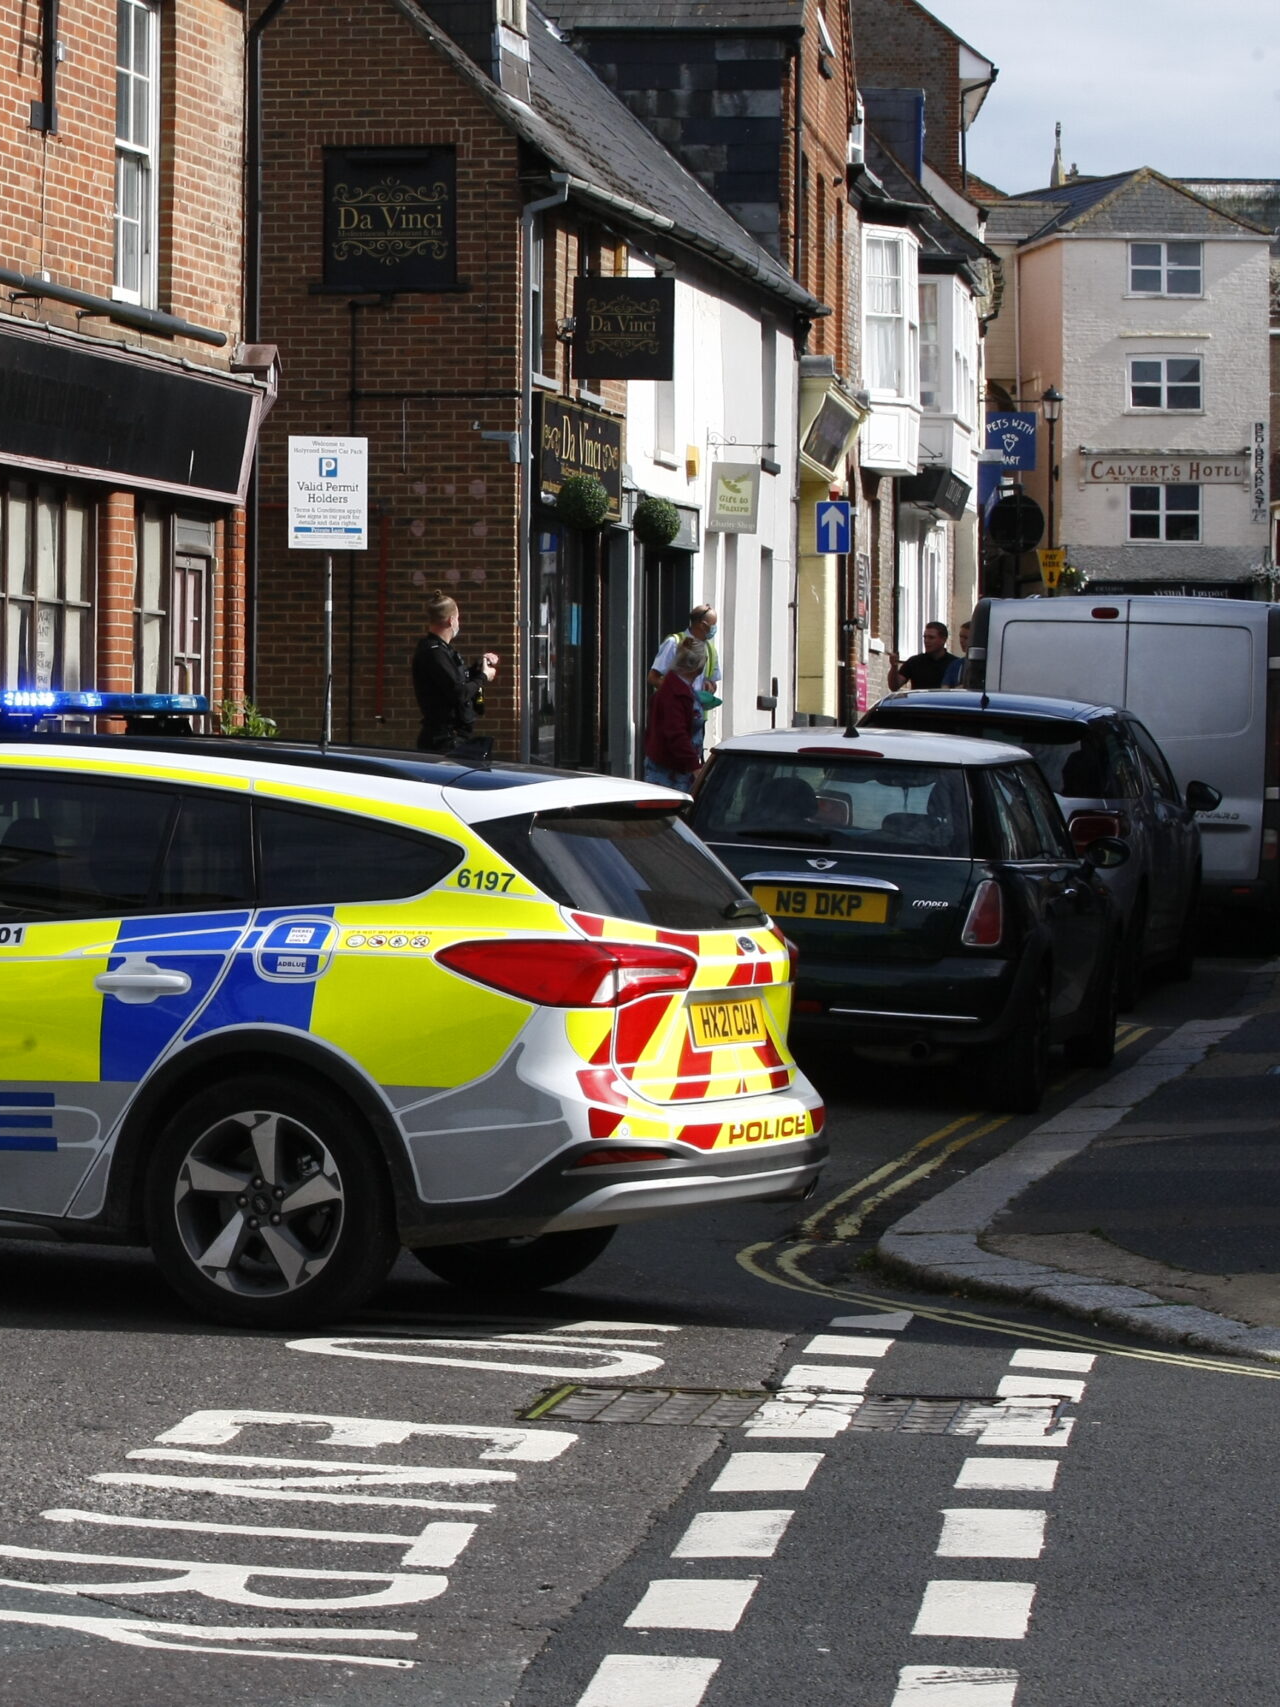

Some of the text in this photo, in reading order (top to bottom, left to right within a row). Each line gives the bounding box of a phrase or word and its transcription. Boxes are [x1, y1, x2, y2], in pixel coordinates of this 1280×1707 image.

[337, 205, 443, 229] Da Vinci
[589, 315, 657, 332] Da Vinci
[985, 418, 1035, 435] PETS WITH
[293, 447, 320, 455] Holyrood
[561, 415, 601, 470] Da Vinci
[321, 458, 336, 477] P
[1090, 460, 1242, 481] CALVERT'S HOTEL
[297, 481, 359, 492] Valid Permit
[1254, 448, 1265, 509] BREAKFAST
[307, 493, 349, 503] Holders
[718, 495, 738, 503] Gift
[718, 503, 749, 513] Nature
[456, 868, 516, 893] 6197
[775, 889, 863, 918] N9 DKP
[911, 899, 949, 909] COOPER
[699, 1002, 760, 1040] HX21 CUA
[728, 1114, 807, 1145] POLICE
